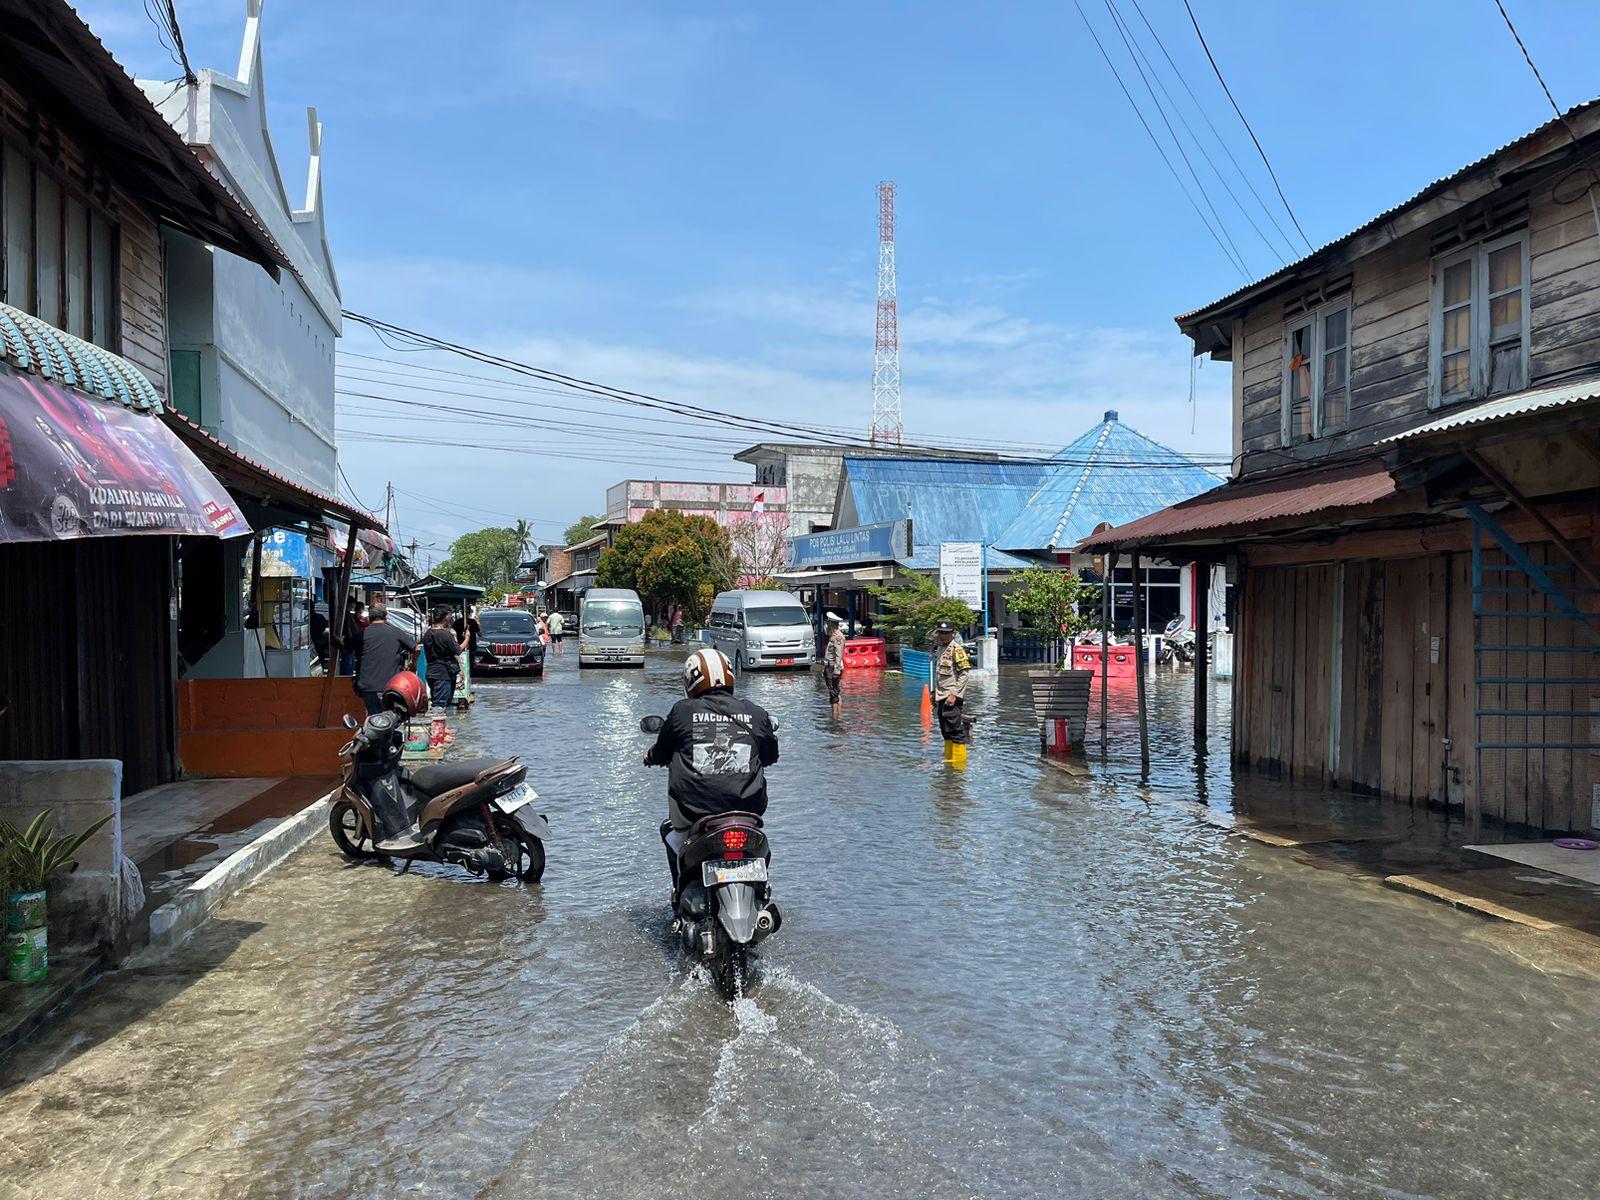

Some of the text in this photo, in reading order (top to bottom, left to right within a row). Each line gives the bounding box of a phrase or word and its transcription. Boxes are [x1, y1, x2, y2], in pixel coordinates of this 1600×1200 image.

[89, 488, 187, 509] KUALITAS MENYALA
[93, 511, 122, 528] DARI
[126, 511, 162, 528] WAKTU
[851, 530, 870, 544] LINTAS
